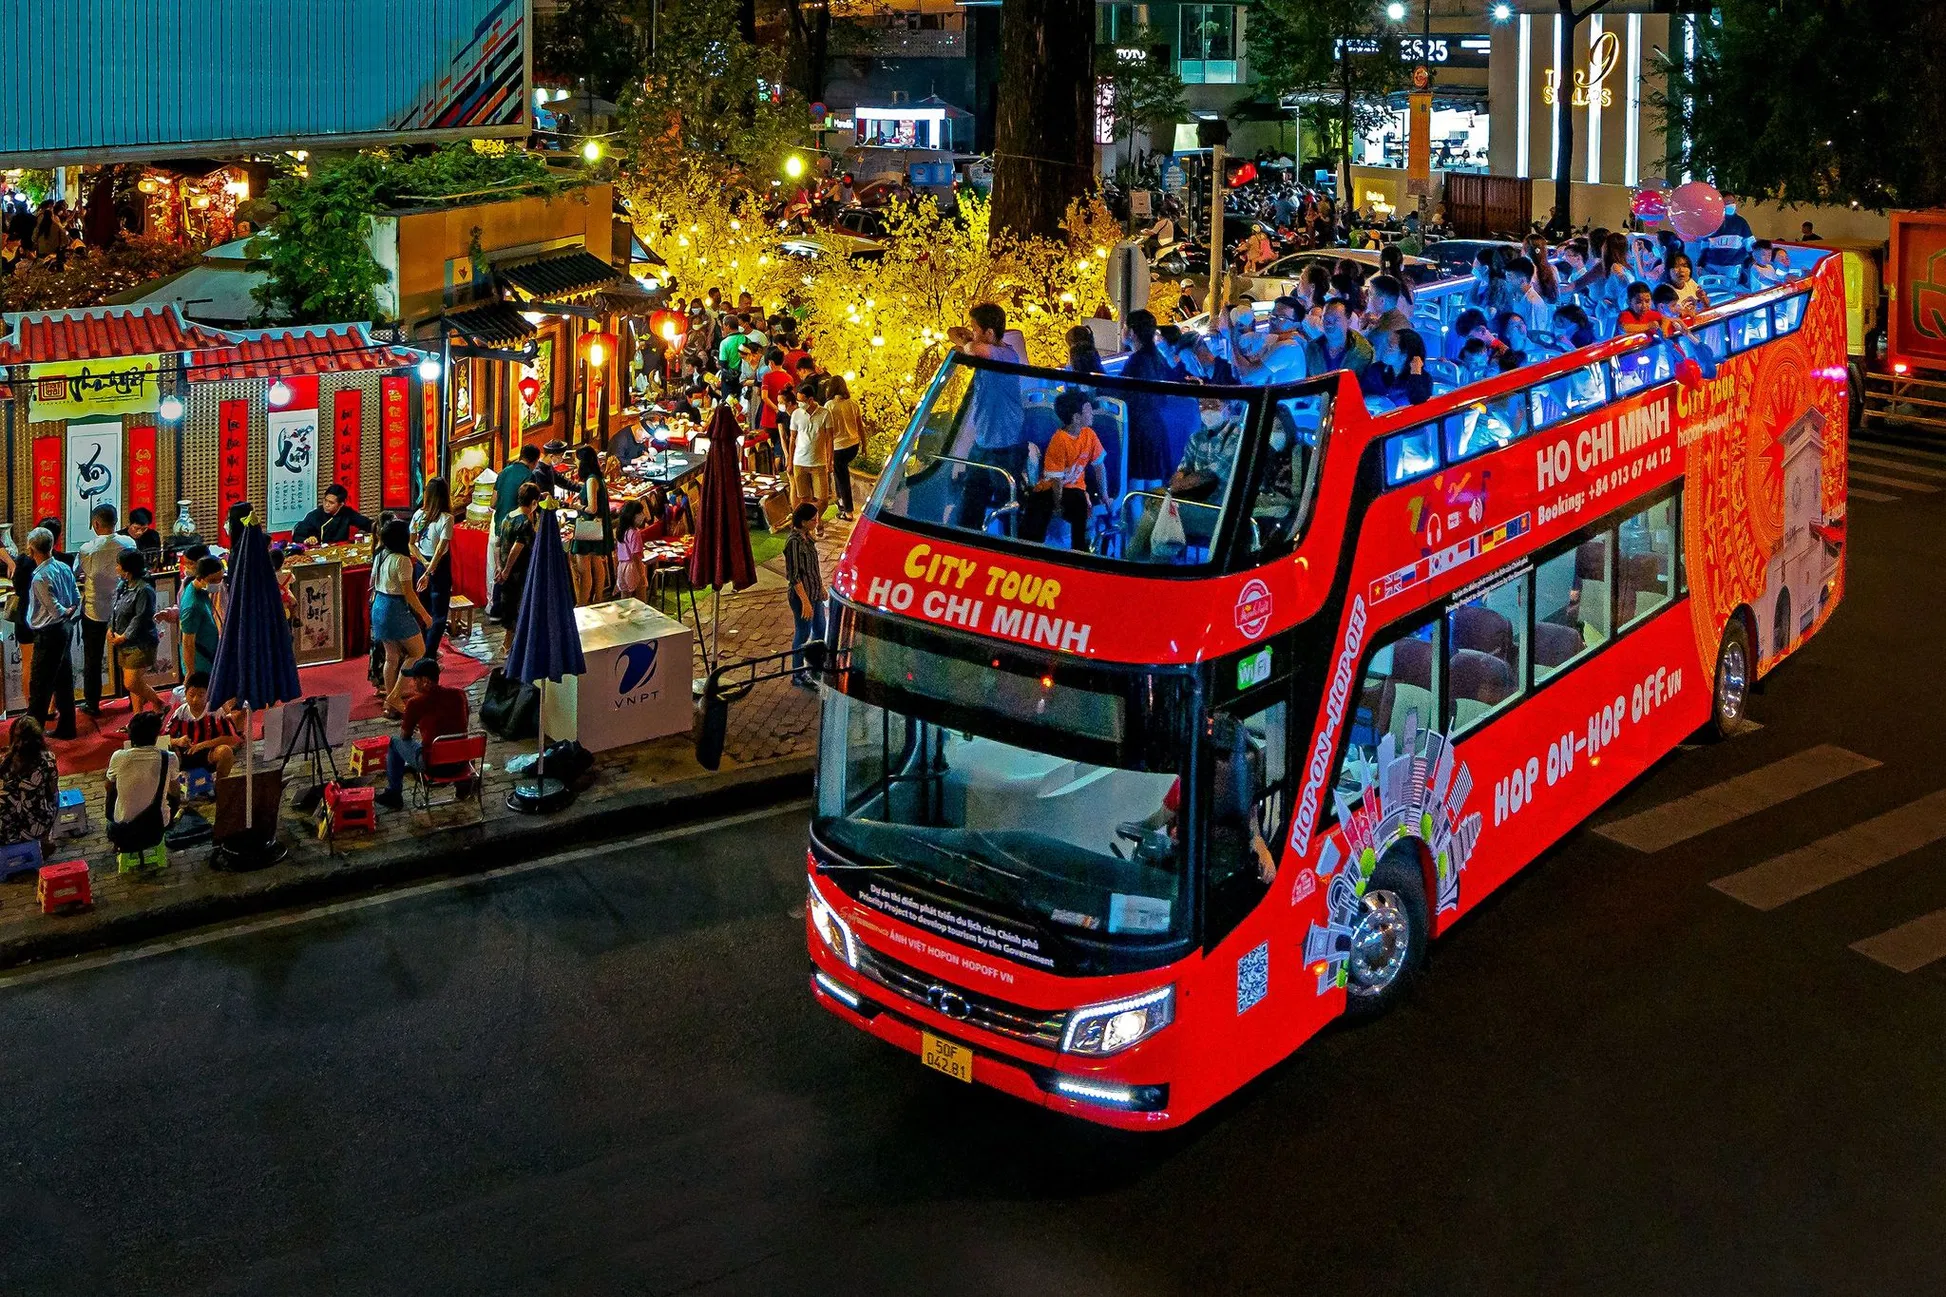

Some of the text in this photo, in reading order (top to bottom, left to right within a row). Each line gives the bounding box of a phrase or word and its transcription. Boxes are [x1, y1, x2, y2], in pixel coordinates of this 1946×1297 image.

[1677, 373, 1735, 419] CITY TOUR
[1536, 396, 1671, 492] HO CHI MINH
[1537, 445, 1671, 526] Booking: +84 913 67 44 12
[903, 543, 1062, 610] CITY TOUR
[867, 576, 1092, 654] HO CHI MINH
[613, 690, 659, 708] VNPT
[1494, 756, 1539, 827] HOP
[1546, 695, 1626, 786] ON-HOP
[859, 890, 1055, 968] Priority Project to develop tourism by the Government
[955, 916, 967, 927] du
[927, 945, 960, 965] HOPON
[961, 958, 999, 979] HOPOFF
[999, 971, 1014, 984] VN
[926, 1051, 965, 1079] 042.81
[935, 1040, 958, 1059] 50F
